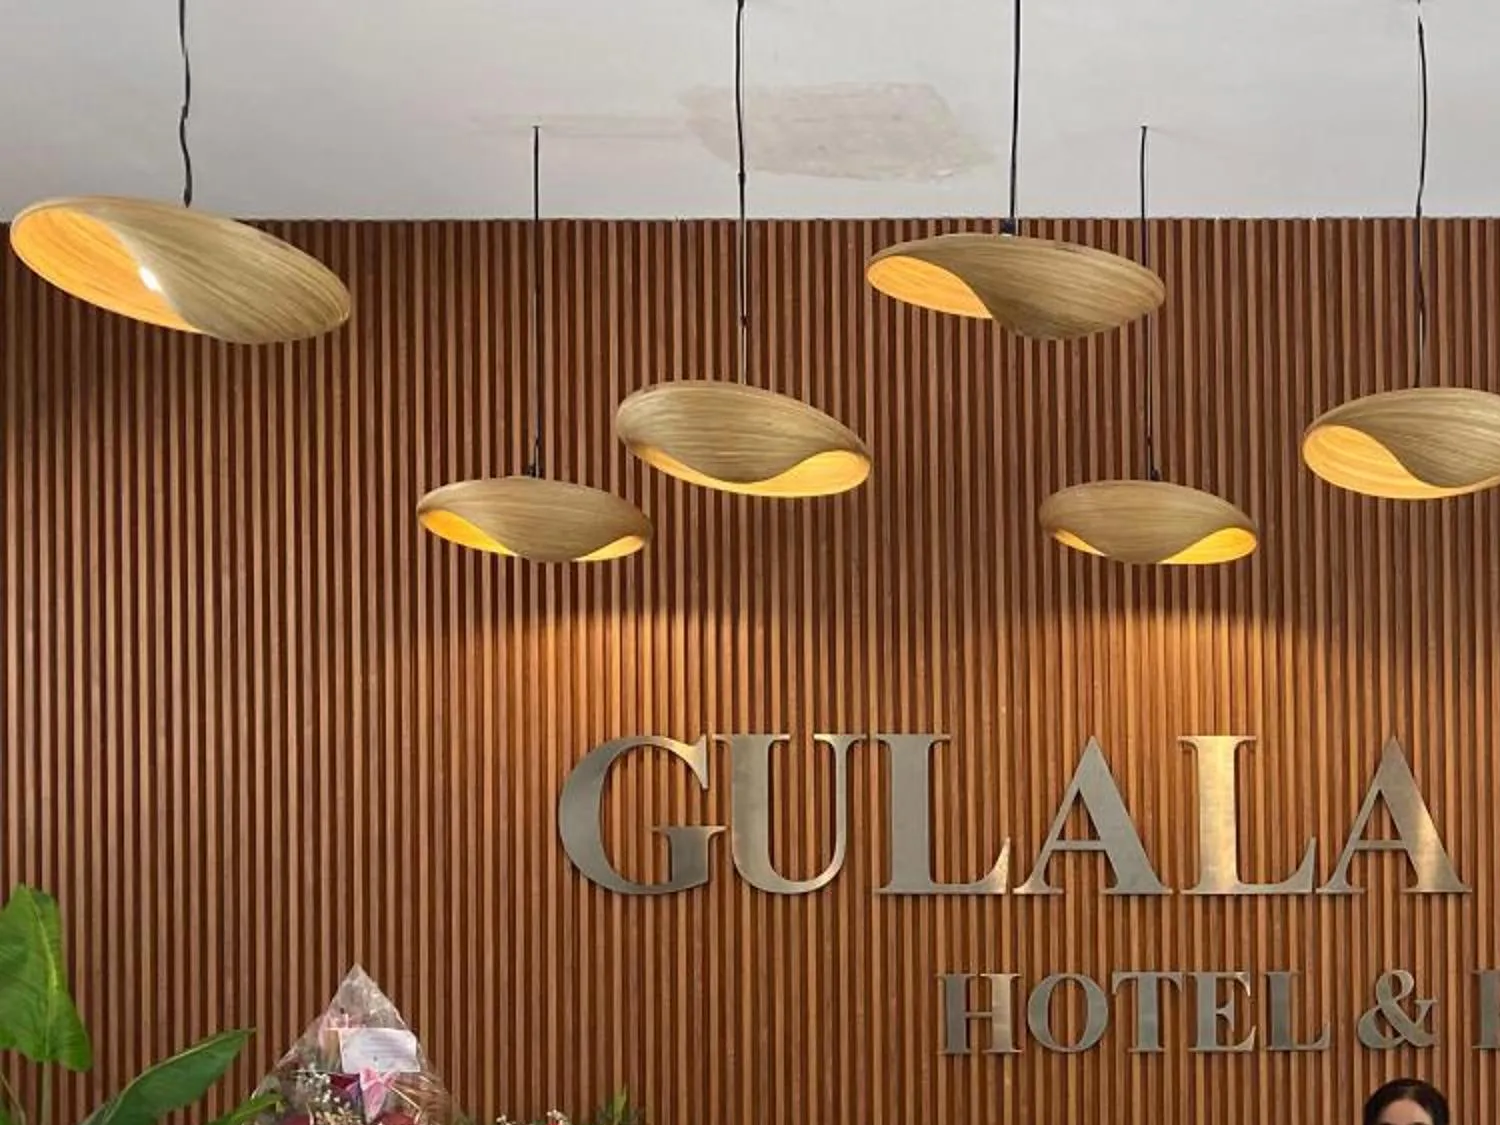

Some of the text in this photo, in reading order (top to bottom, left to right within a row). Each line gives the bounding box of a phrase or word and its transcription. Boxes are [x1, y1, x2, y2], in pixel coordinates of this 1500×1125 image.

[558, 733, 1473, 895] GULALA
[936, 970, 1331, 1056] HOTEL
[1357, 968, 1438, 1050] &
